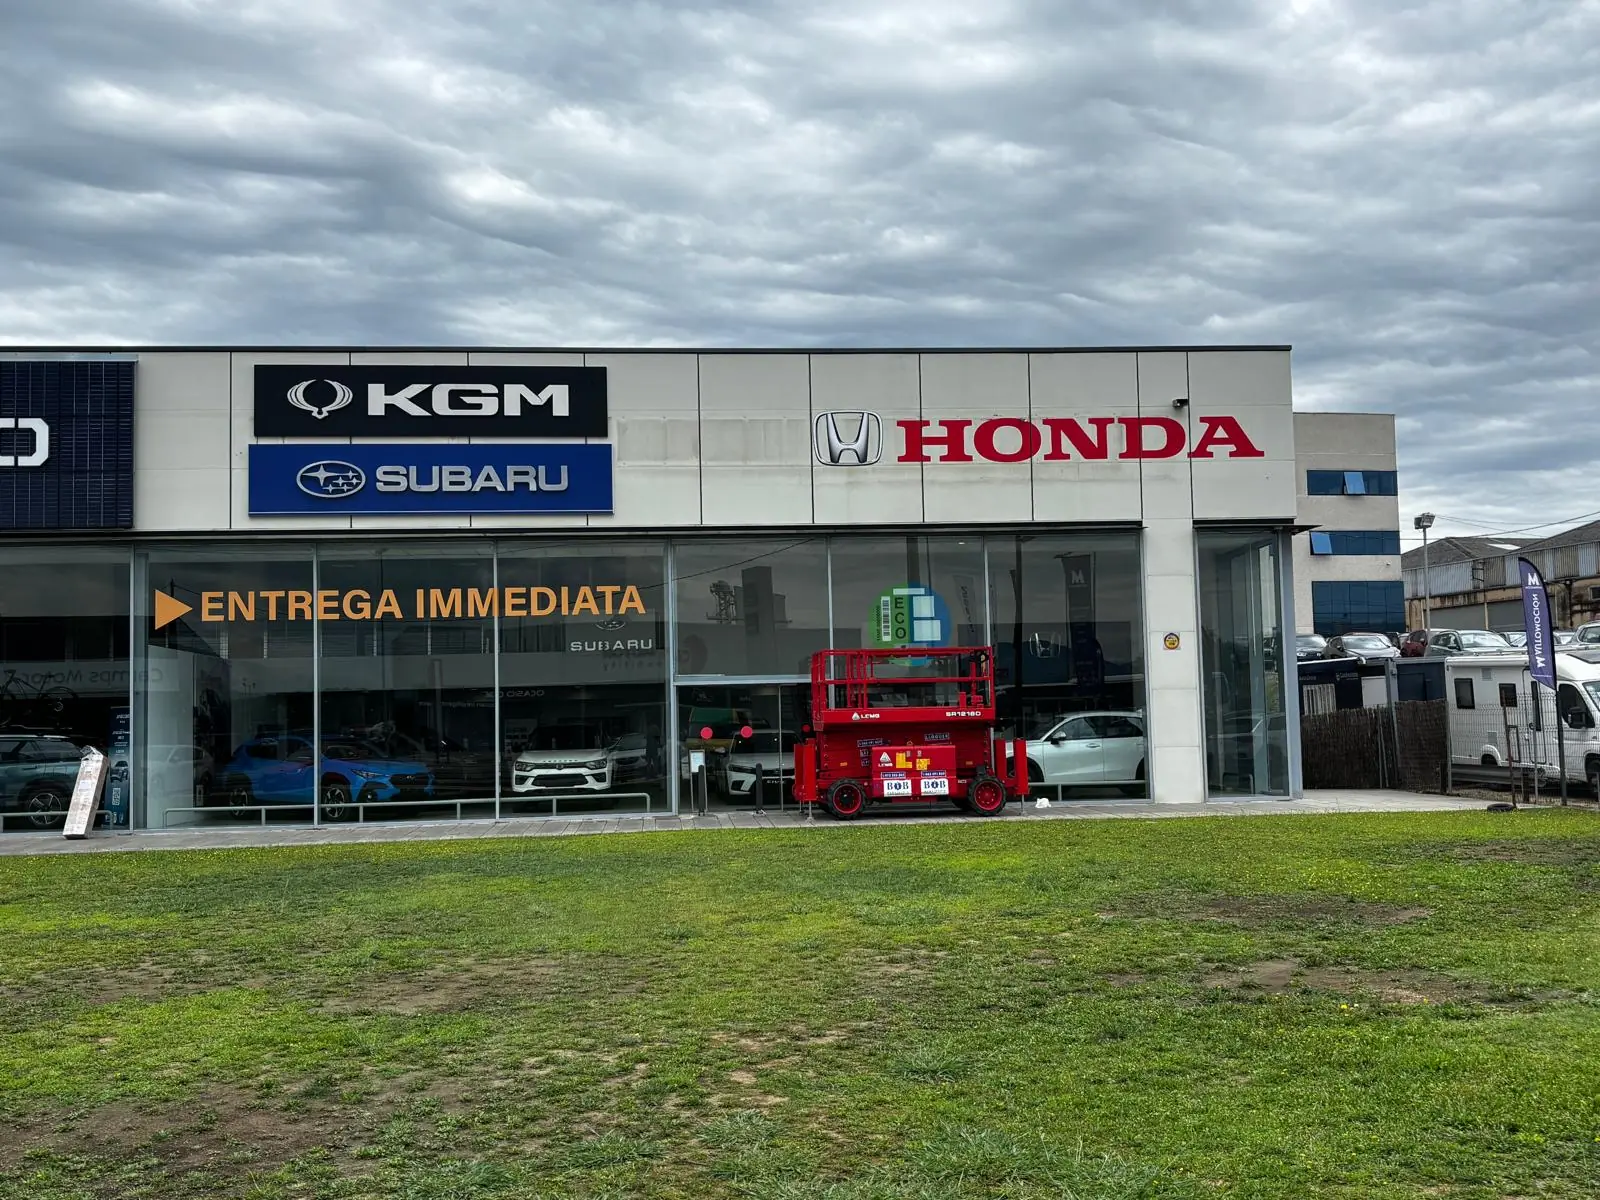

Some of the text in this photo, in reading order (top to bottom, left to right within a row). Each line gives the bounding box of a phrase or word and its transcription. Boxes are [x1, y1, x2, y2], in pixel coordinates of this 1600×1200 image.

[368, 383, 570, 417] KGM
[896, 416, 1265, 462] HONDA
[375, 465, 569, 492] SUBARU
[201, 585, 646, 622] ENTREGA IMMEDIATA
[894, 597, 907, 639] ECO
[570, 638, 653, 652] SUBARU
